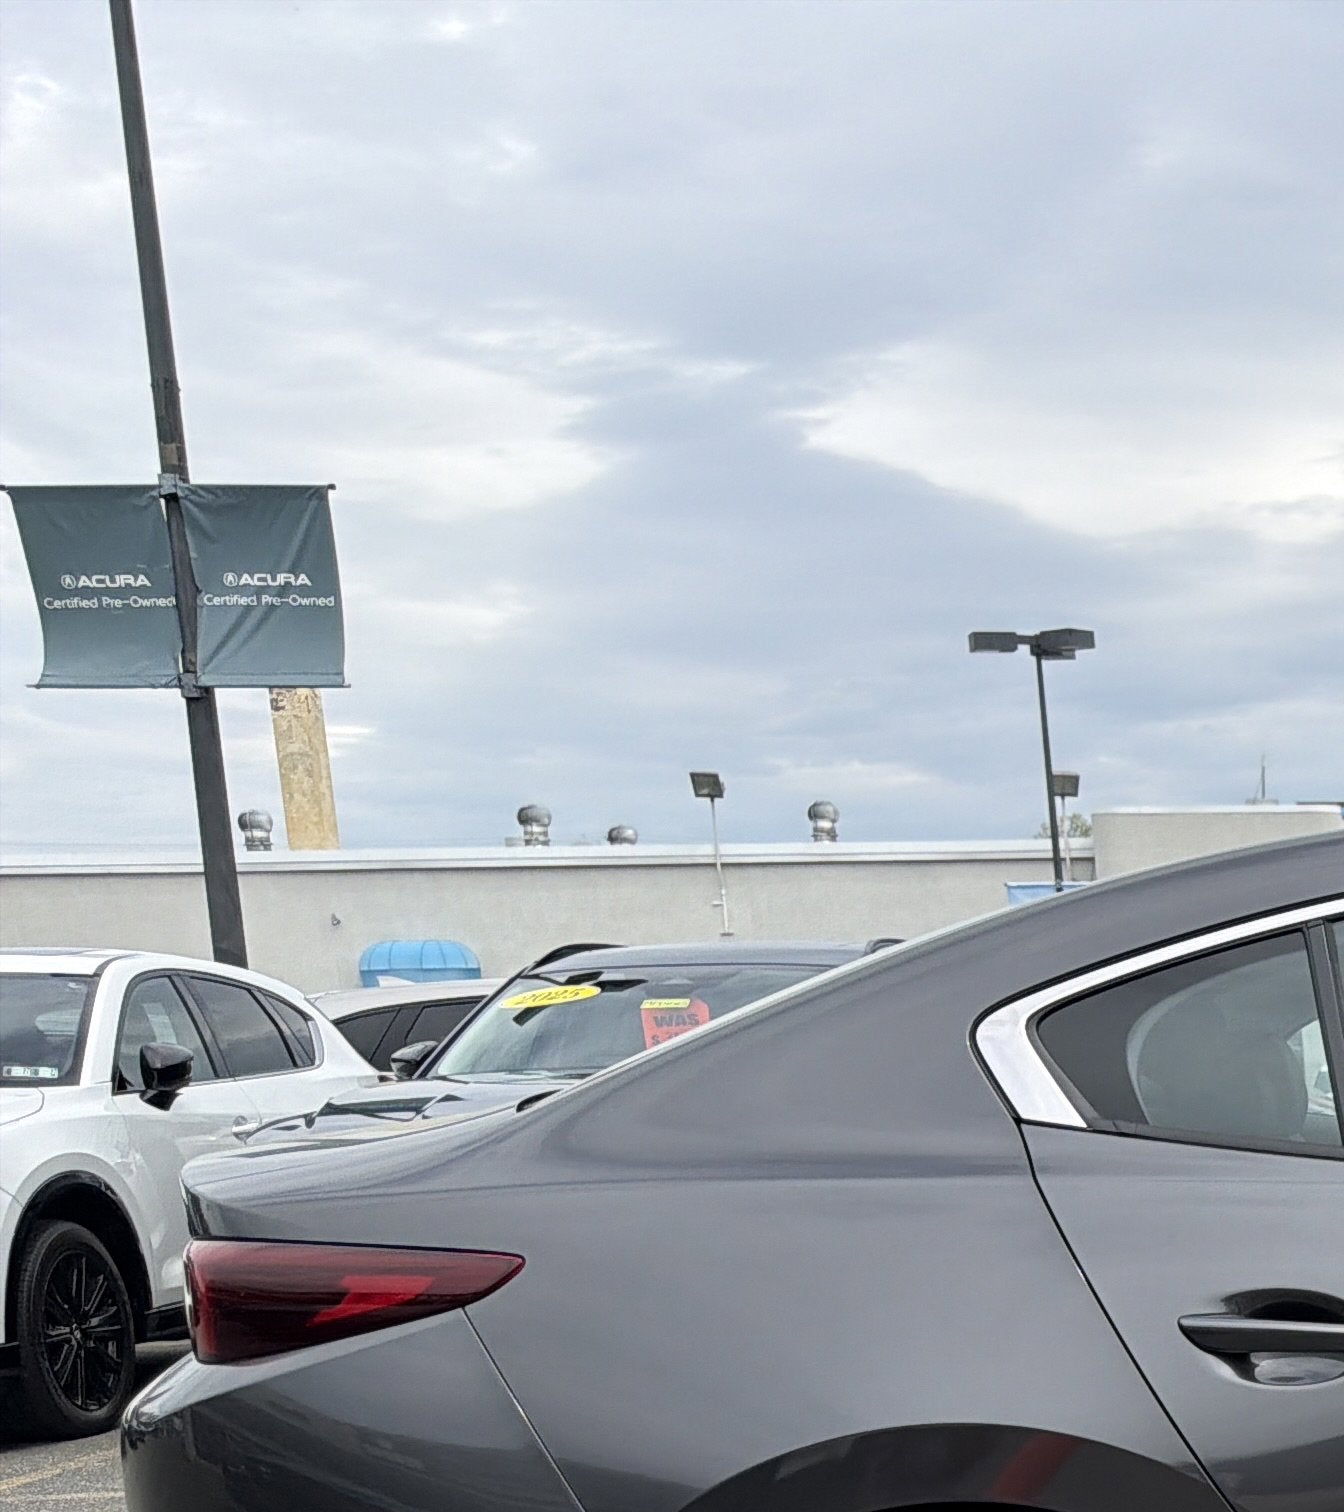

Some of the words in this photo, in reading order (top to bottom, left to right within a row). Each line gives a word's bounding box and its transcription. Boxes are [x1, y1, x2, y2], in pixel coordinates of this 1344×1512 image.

[77, 574, 152, 588] ACURA
[238, 573, 312, 586] ACURA
[43, 597, 99, 609] Certified
[203, 594, 258, 606] Certified
[261, 594, 335, 607] Pre-Owned
[653, 1013, 700, 1028] WAS
